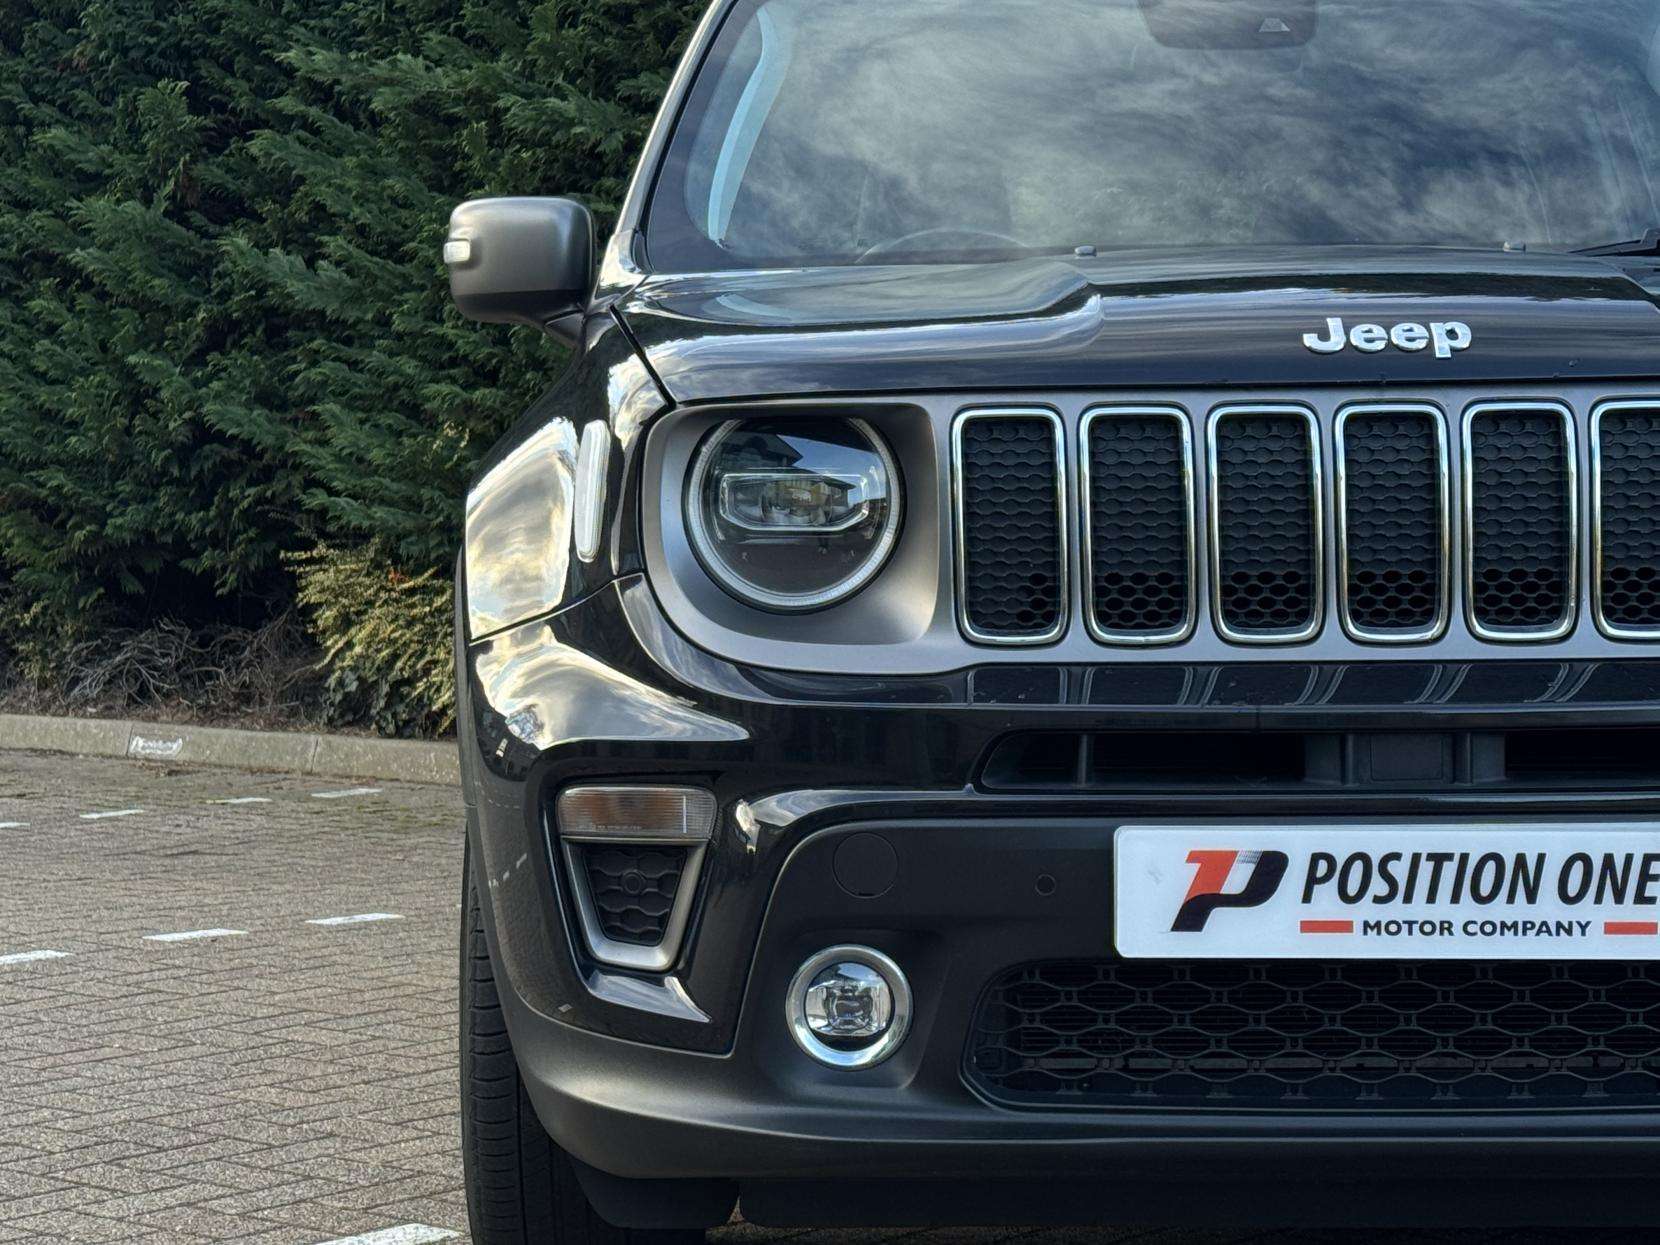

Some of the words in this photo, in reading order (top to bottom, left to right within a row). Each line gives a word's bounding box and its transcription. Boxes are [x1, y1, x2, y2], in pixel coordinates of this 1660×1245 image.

[1303, 317, 1472, 359] Jeep
[1301, 851, 1547, 905] POSITION
[1557, 851, 1660, 905] ONE
[1362, 919, 1454, 936] MOTOR
[1462, 919, 1592, 937] COMPANY
